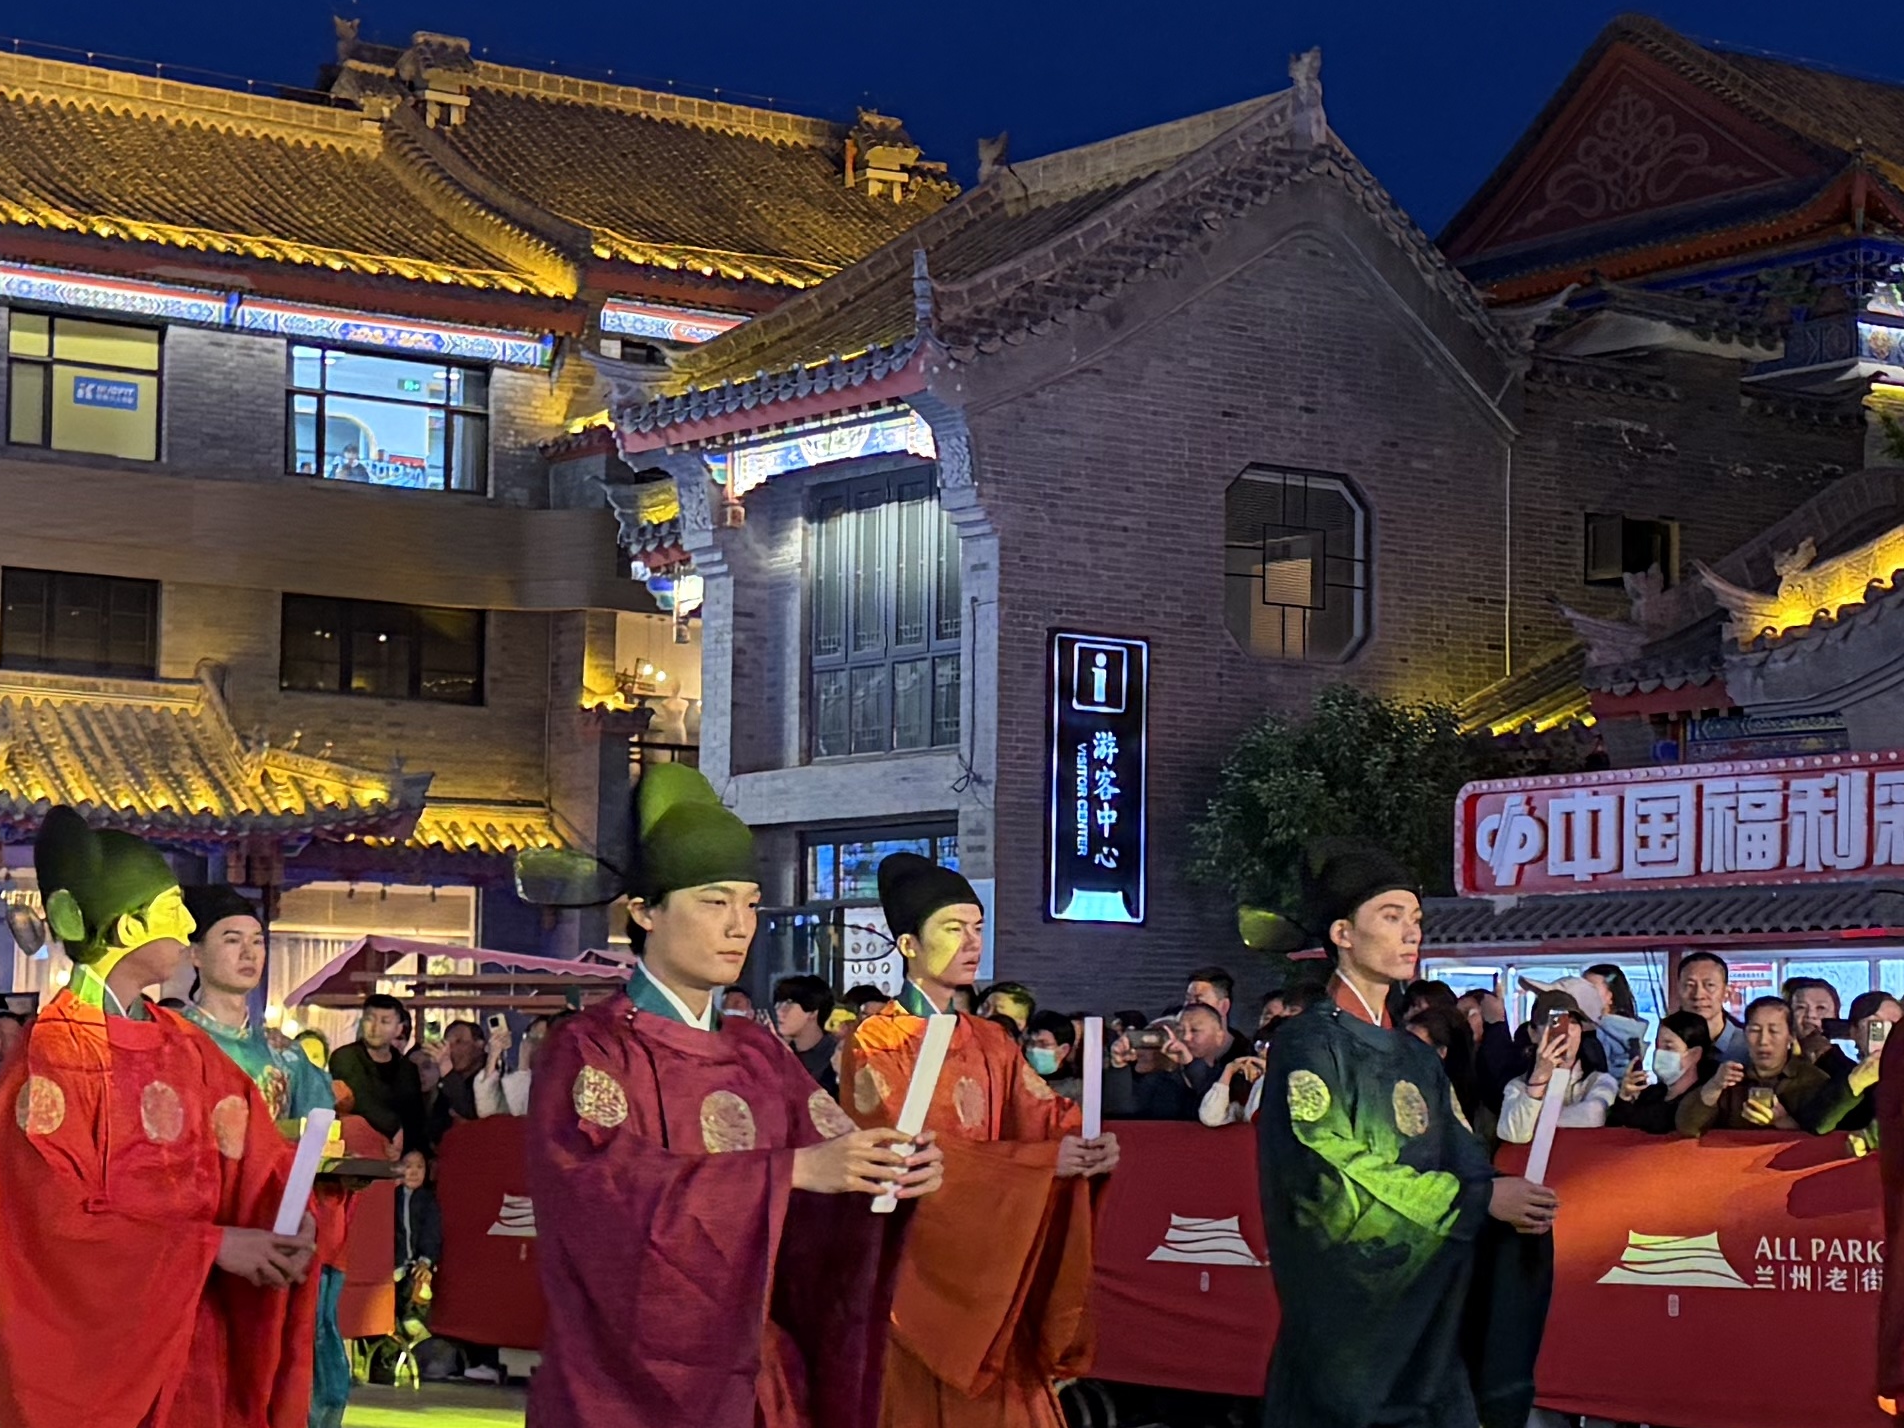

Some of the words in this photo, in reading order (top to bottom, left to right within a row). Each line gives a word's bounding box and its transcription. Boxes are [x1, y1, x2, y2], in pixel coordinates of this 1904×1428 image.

[1077, 742, 1088, 797] VISITOR
[1077, 799, 1089, 856] CENTER
[1093, 731, 1121, 869] 游客中心
[1754, 1236, 1802, 1261] ALL
[1811, 1238, 1885, 1264] PARK
